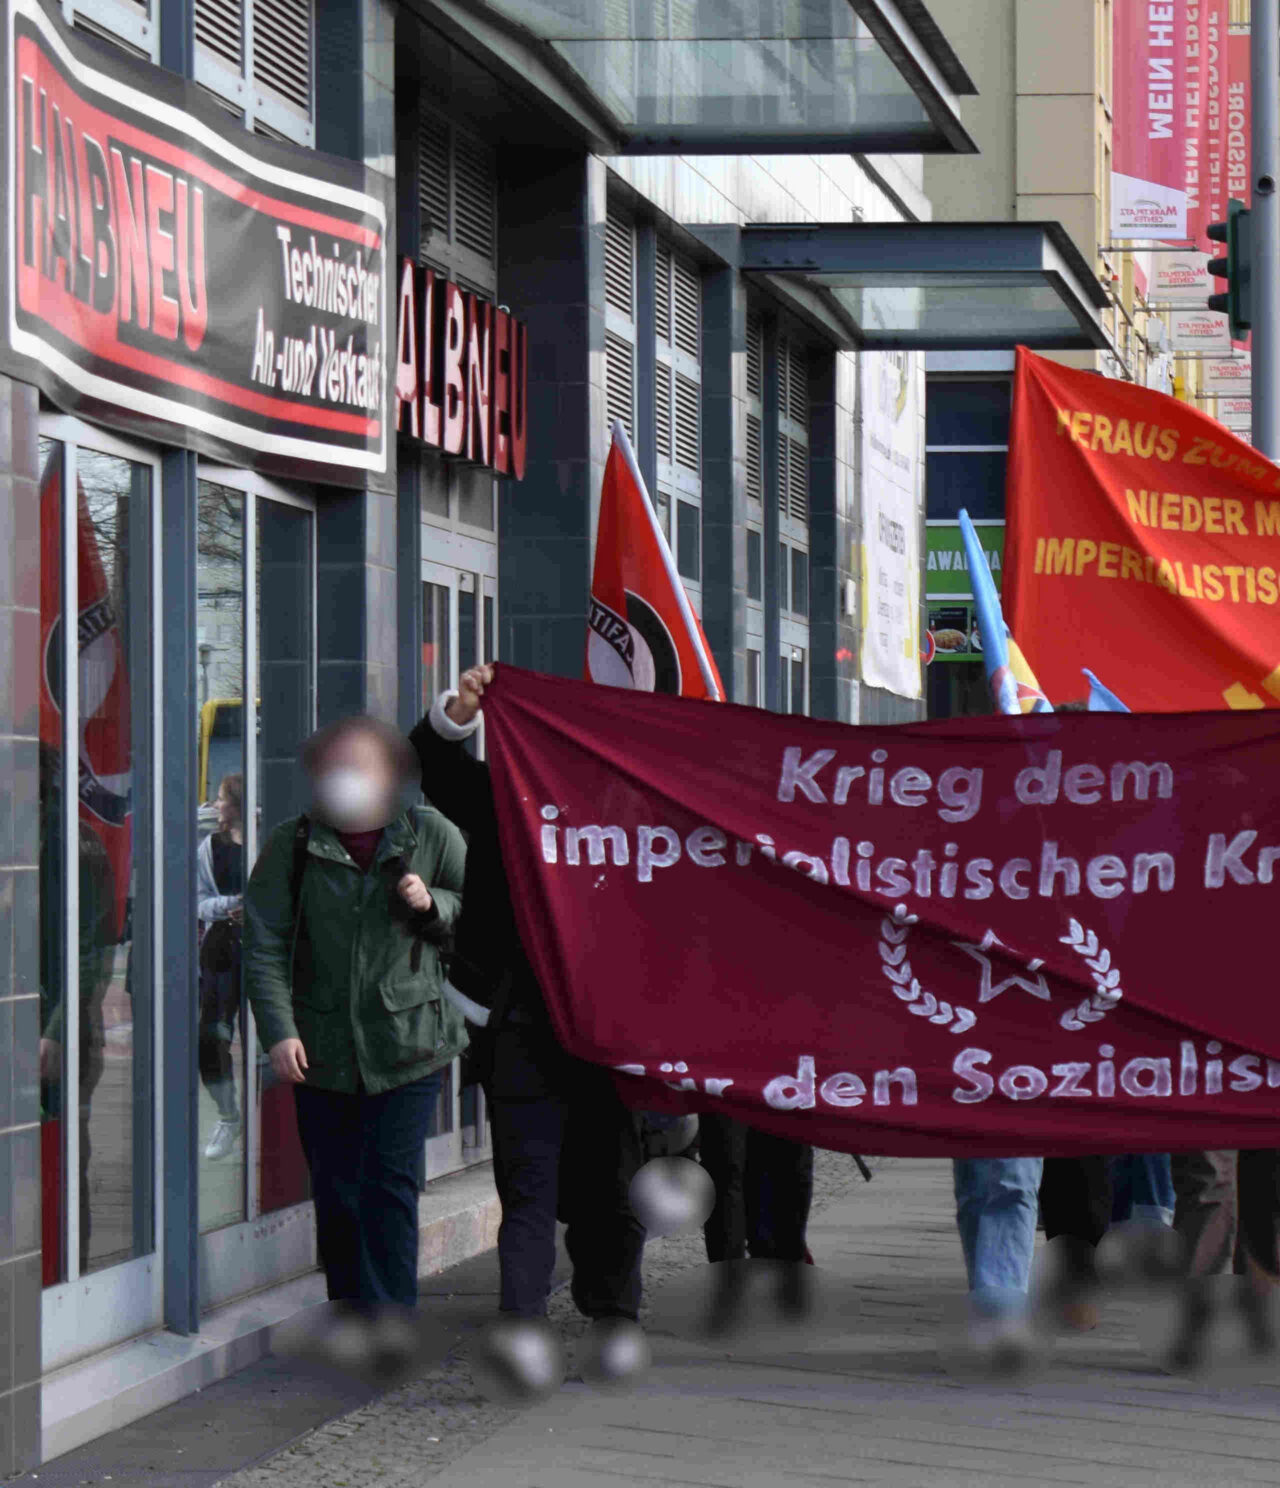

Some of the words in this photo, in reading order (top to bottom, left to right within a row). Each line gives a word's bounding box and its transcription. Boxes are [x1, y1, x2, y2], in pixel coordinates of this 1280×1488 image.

[21, 72, 208, 352] HALBNEU
[276, 225, 380, 326] Technischer
[318, 325, 381, 411] Verkauf
[394, 256, 527, 481] ALBNEU
[1125, 488, 1249, 536] NIEDER
[777, 746, 984, 823] Krieg
[1013, 749, 1174, 806] dem
[763, 1055, 919, 1110] den
